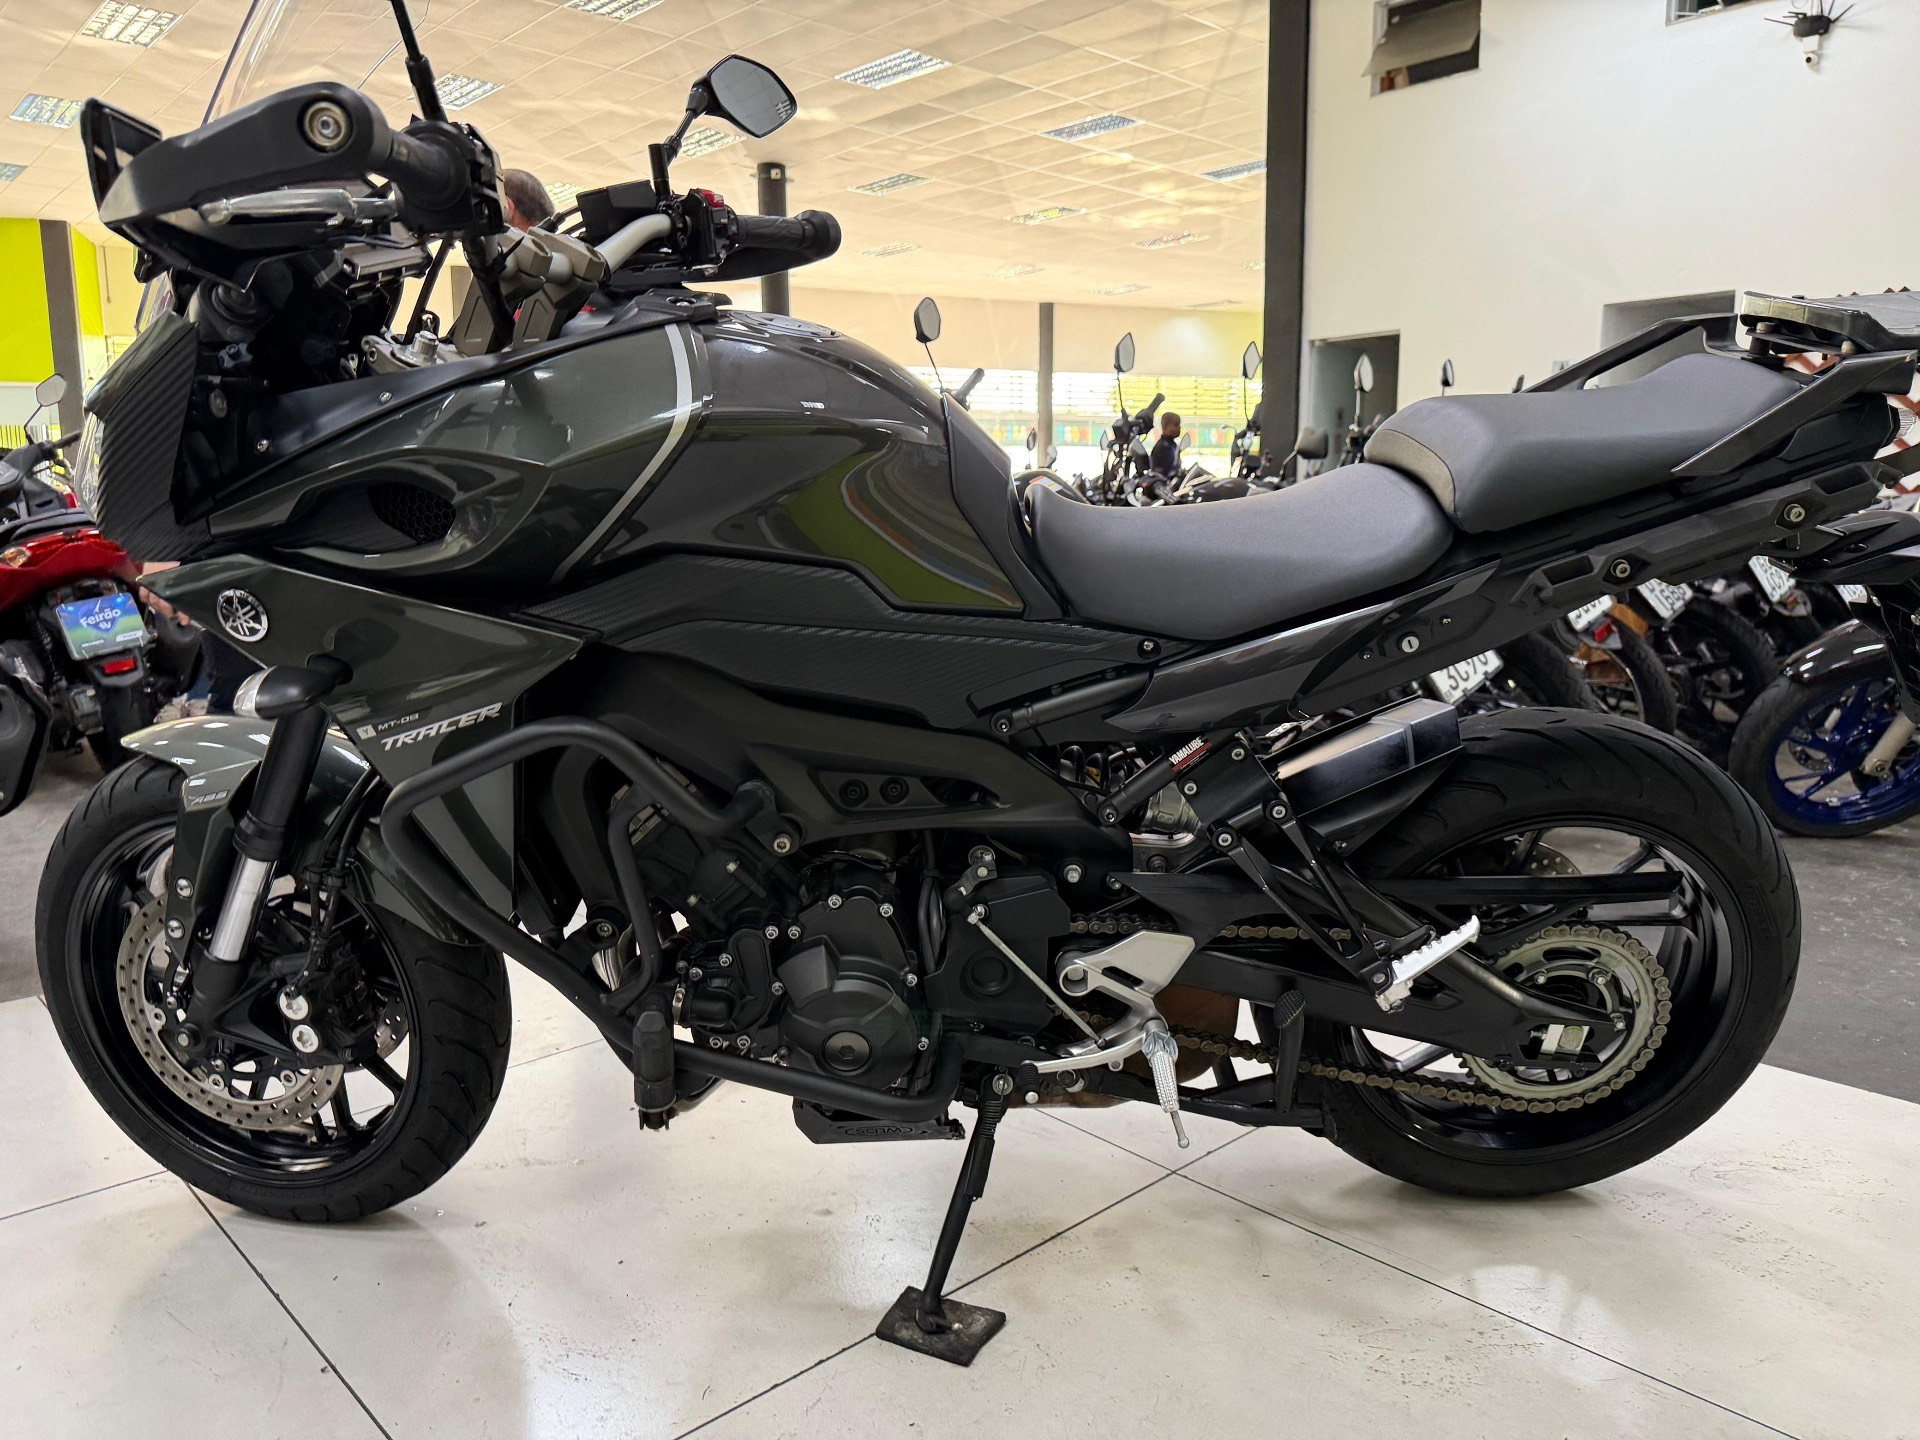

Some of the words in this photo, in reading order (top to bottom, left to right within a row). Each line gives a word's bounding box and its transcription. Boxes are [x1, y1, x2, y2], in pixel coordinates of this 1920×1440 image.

[80, 607, 122, 628] Feirão
[377, 713, 419, 731] MT-09
[380, 702, 503, 751] TRACER
[1168, 735, 1205, 765] YAMALUBE
